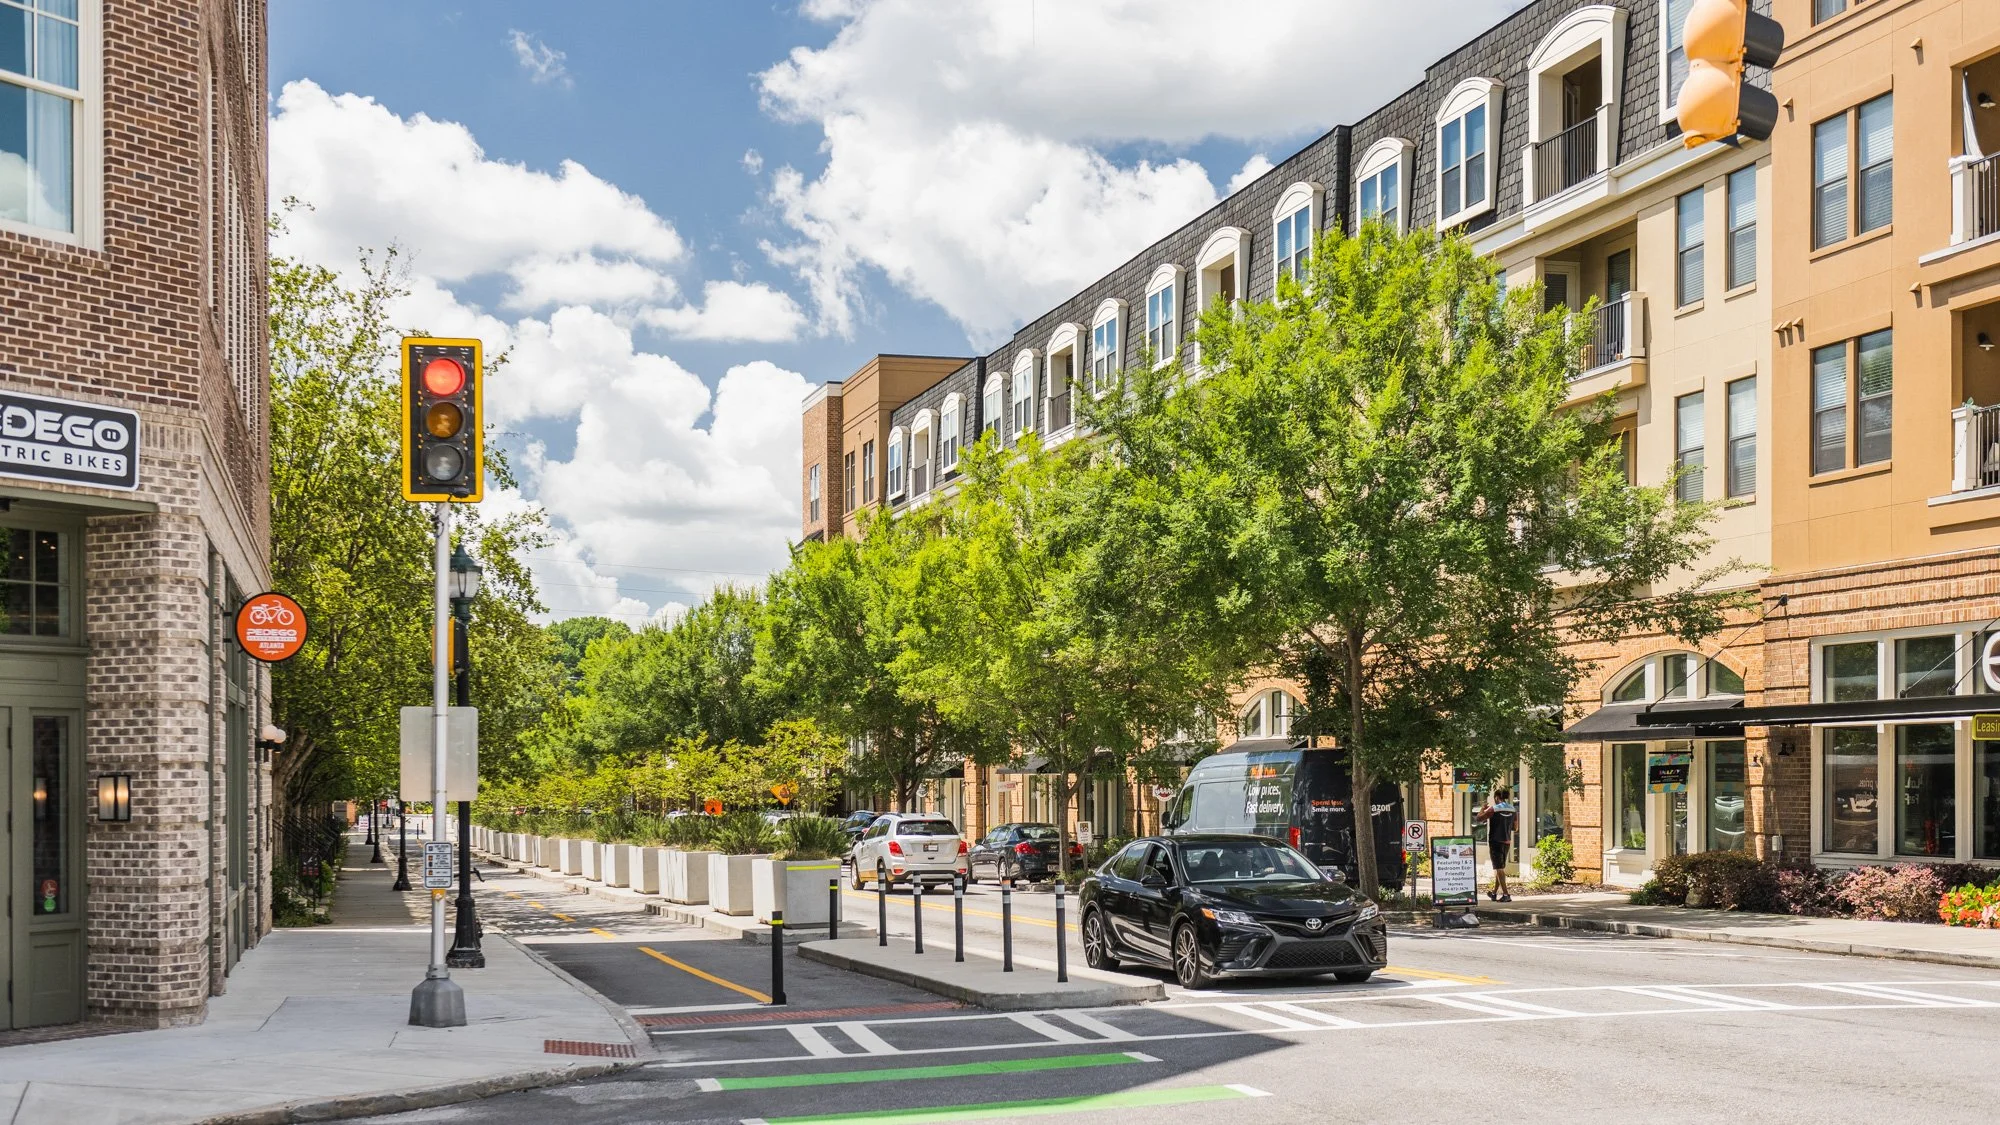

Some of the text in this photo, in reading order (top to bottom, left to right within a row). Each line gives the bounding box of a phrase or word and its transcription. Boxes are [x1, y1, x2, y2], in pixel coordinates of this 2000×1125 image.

[0, 404, 129, 451] DEGO
[64, 453, 121, 471] BIKES
[247, 628, 297, 637] PEDEGO
[1246, 800, 1284, 816] Fast delivery.
[1371, 804, 1390, 812] azon
